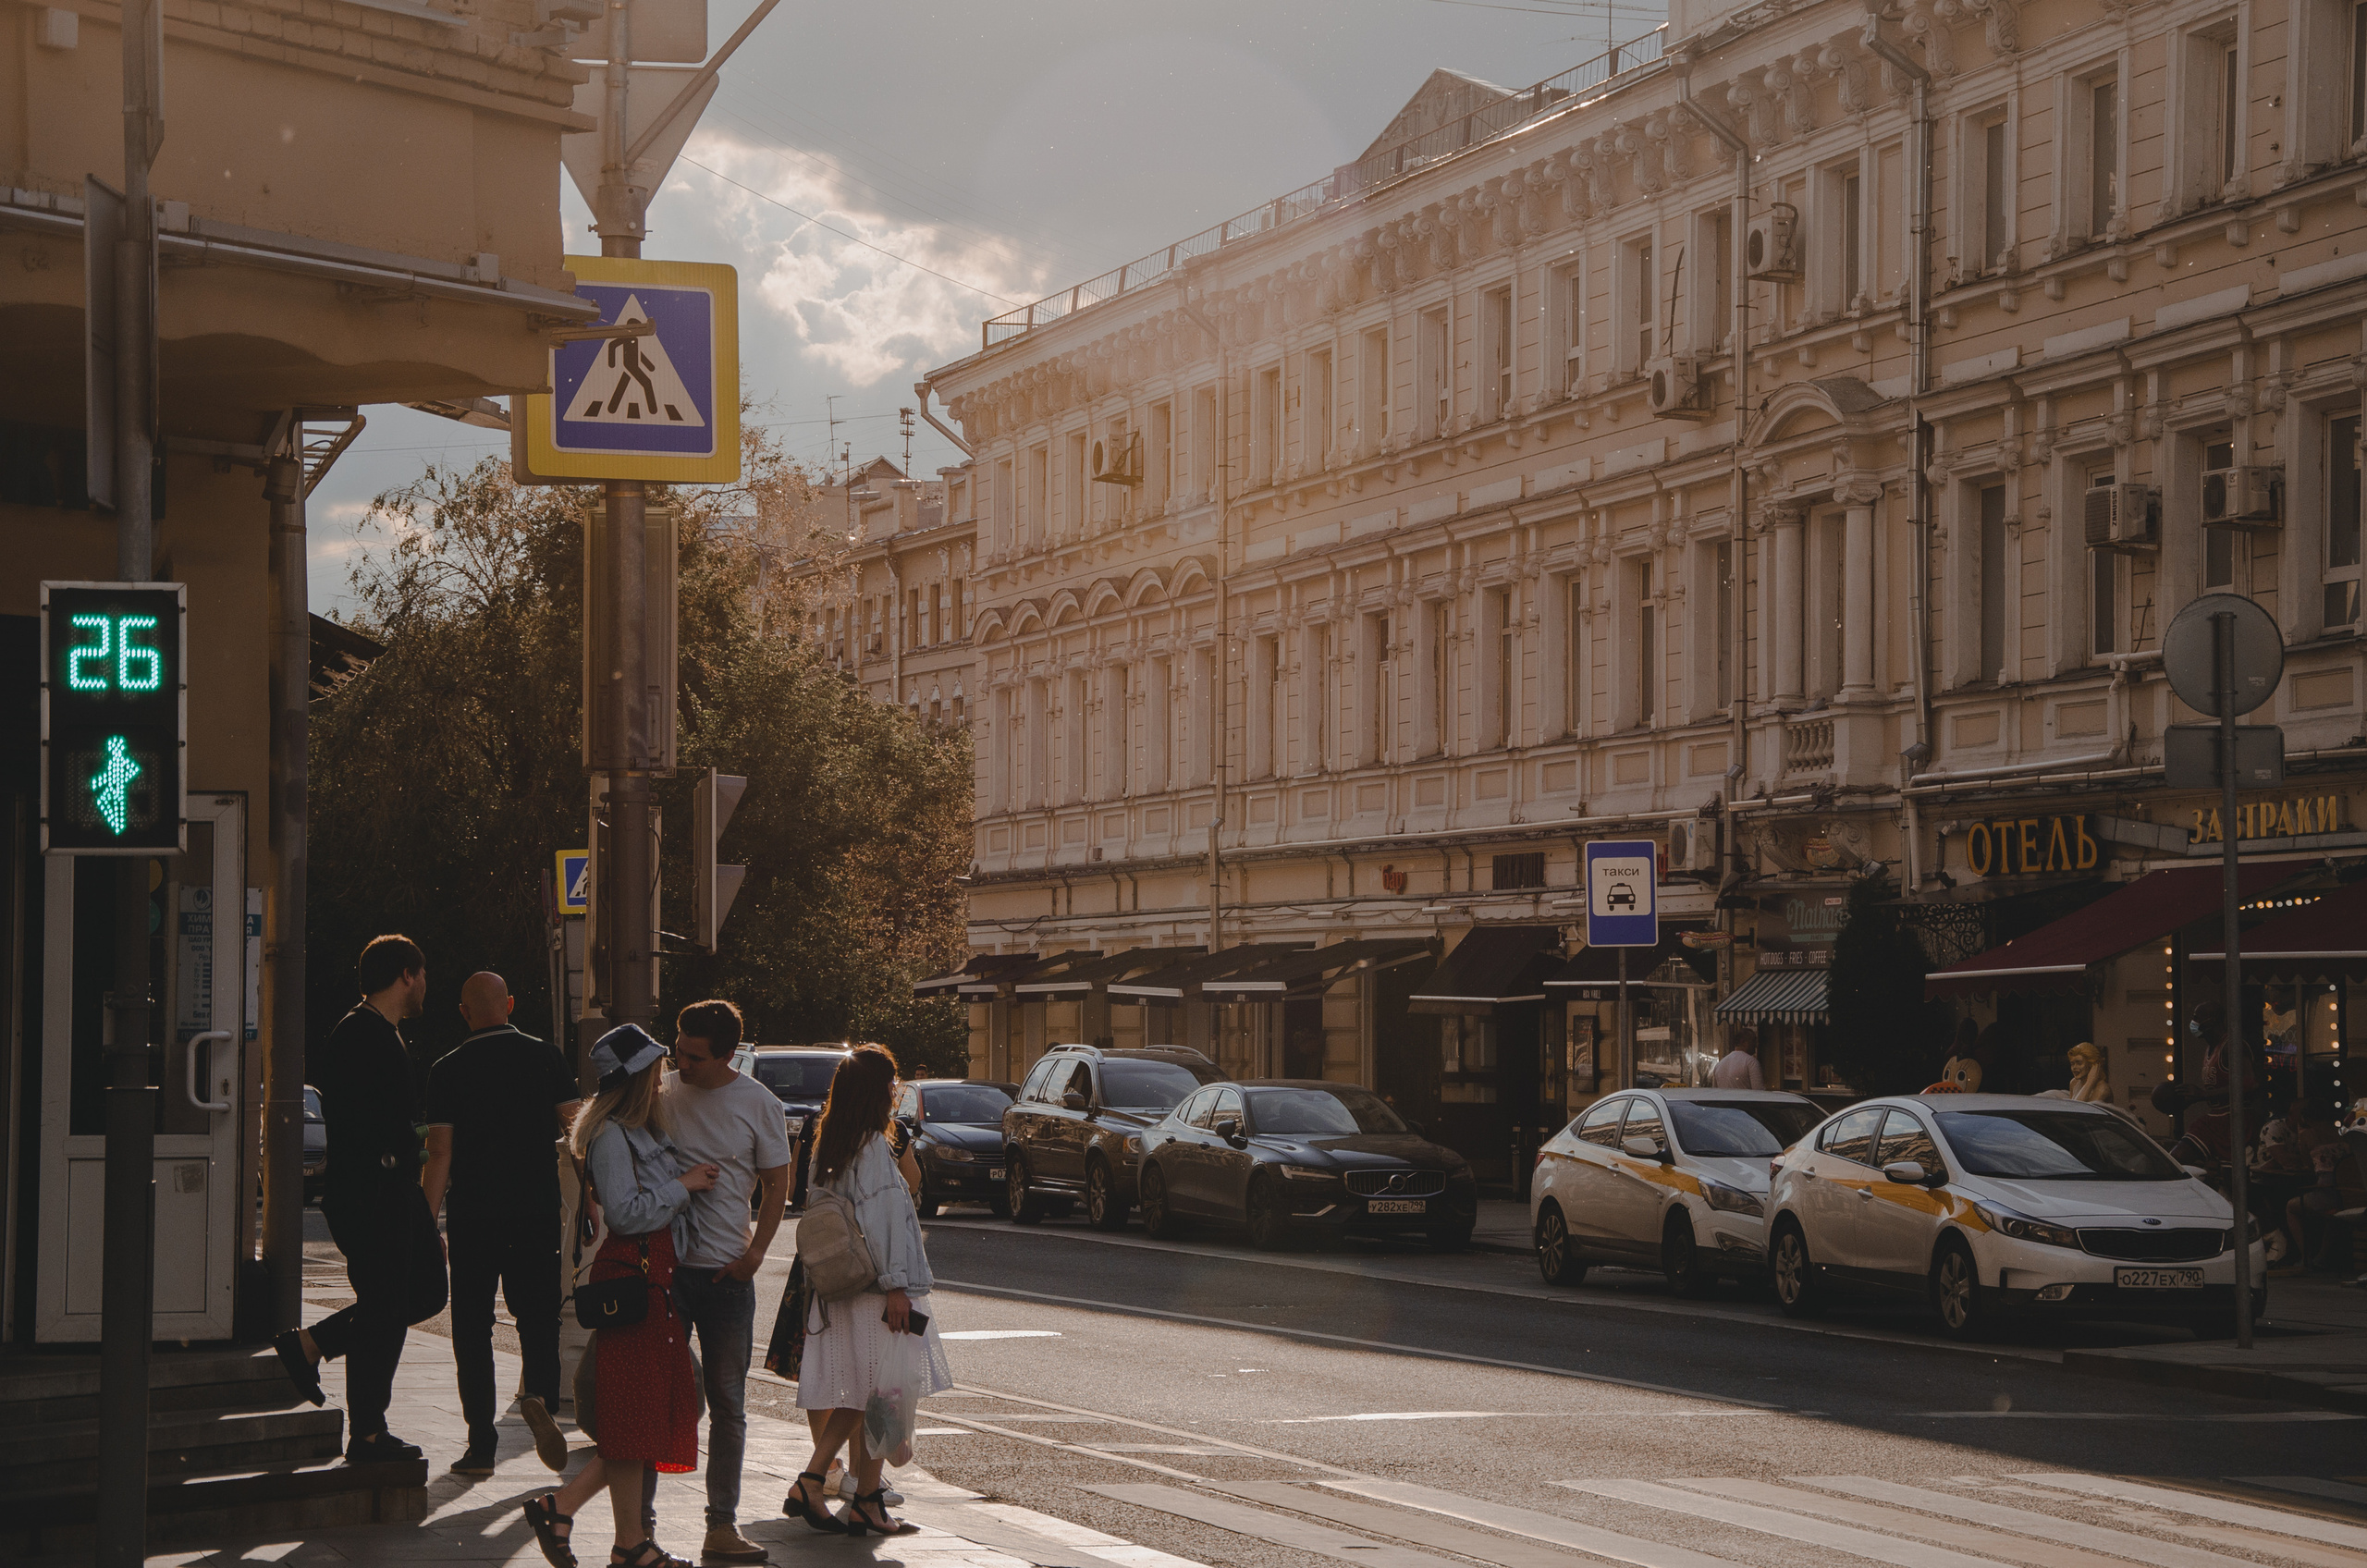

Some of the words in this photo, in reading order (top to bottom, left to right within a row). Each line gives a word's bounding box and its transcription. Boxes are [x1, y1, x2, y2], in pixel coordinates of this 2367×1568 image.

[69, 615, 159, 690] 26
[1967, 815, 2098, 876] ОТЕЛЬ
[1602, 868, 1639, 876] такси
[1809, 950, 1827, 964] COFFEE
[1371, 1201, 1408, 1212] У282ХЕ
[1409, 1201, 1424, 1209] 799
[2122, 1271, 2177, 1286] О227ЕХ
[2178, 1271, 2199, 1282] 790
